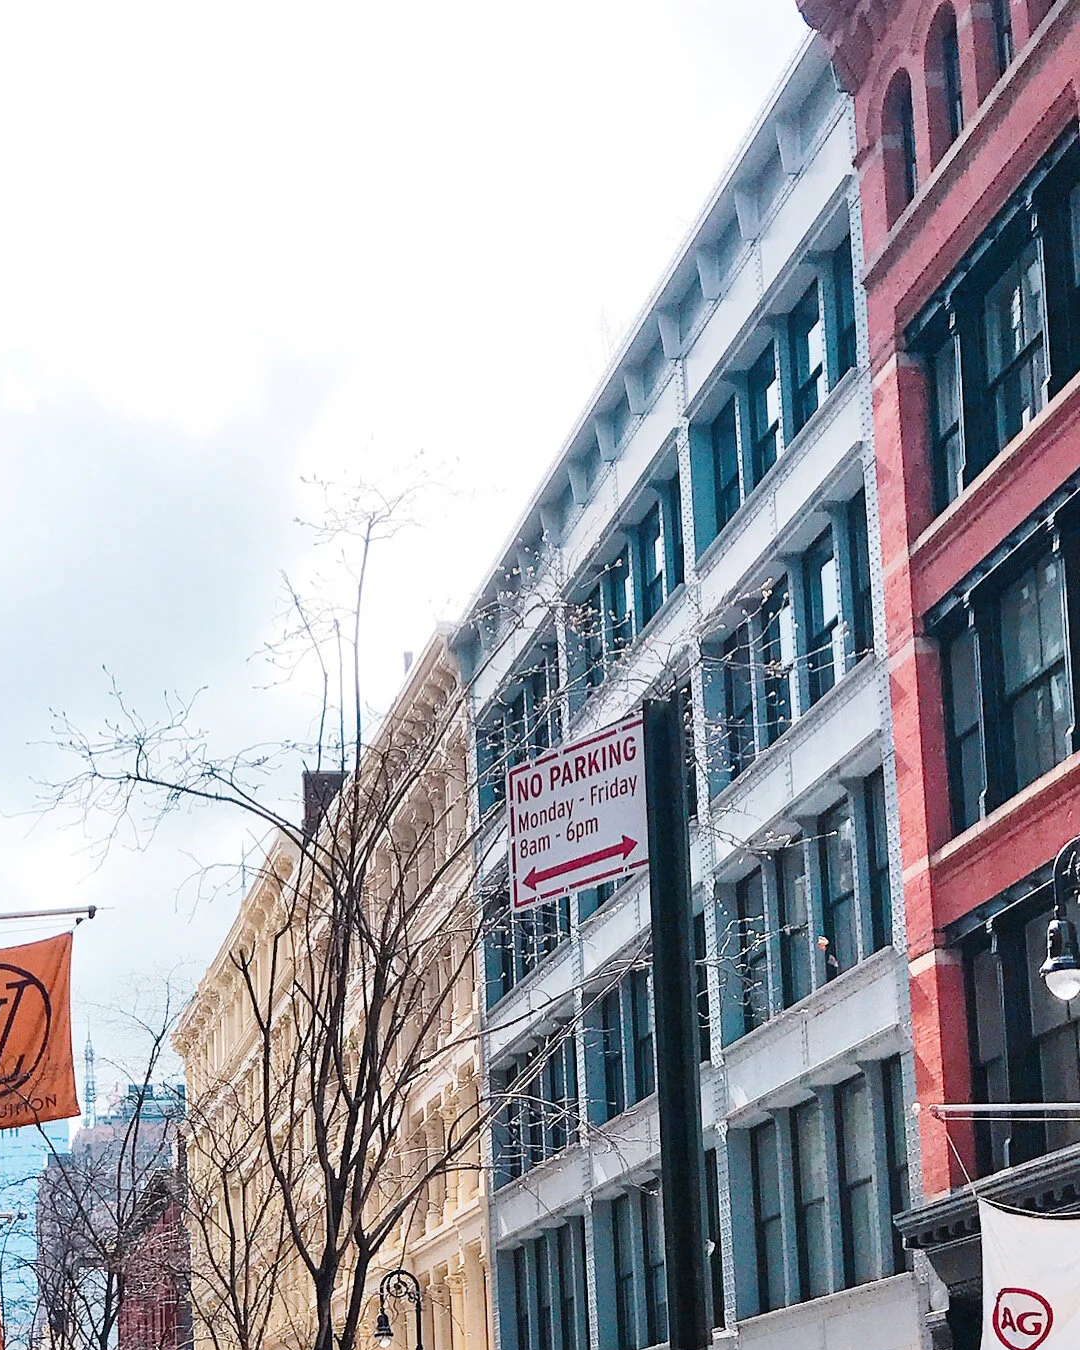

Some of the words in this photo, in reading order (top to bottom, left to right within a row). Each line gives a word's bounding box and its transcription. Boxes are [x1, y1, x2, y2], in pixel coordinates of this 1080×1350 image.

[516, 772, 543, 804] NO
[550, 736, 637, 791] PARKING
[519, 797, 574, 834] Monday
[590, 775, 638, 806] Friday
[520, 836, 551, 859] 8am
[566, 817, 599, 843] 6pm
[1001, 1307, 1042, 1336] AG
